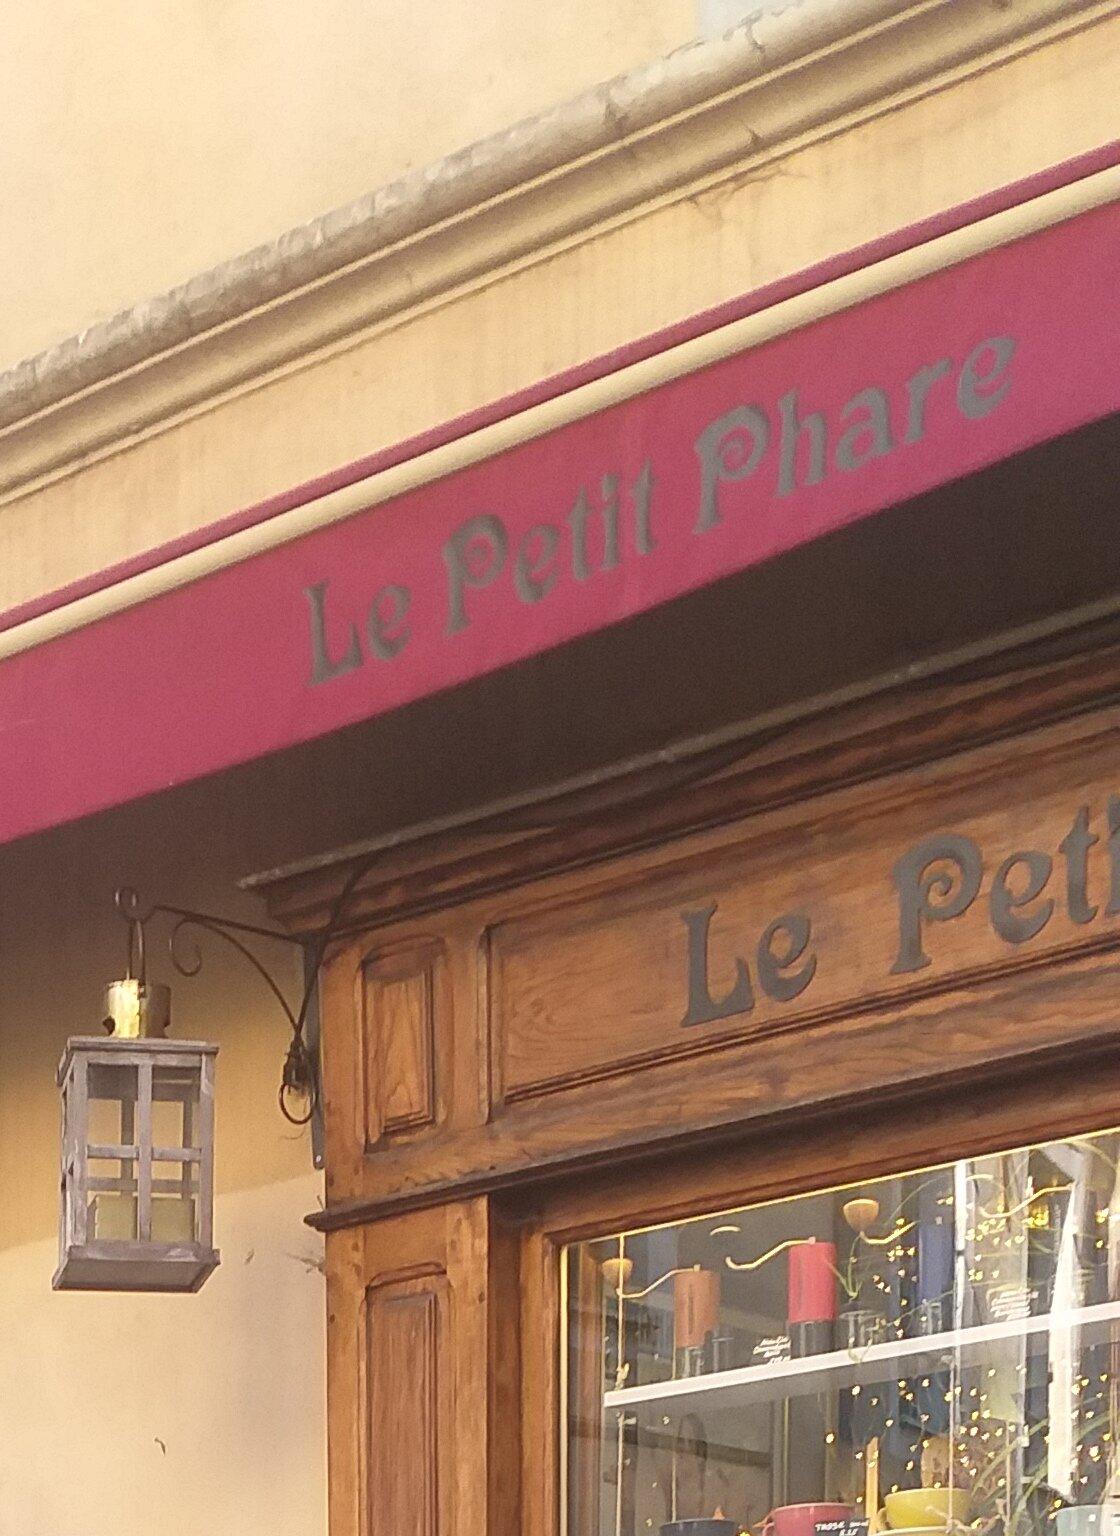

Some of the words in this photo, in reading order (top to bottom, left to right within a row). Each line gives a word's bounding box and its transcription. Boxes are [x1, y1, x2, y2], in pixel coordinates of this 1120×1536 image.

[302, 579, 412, 687] Le
[441, 458, 657, 637] Petit
[692, 334, 1017, 535] Phare
[680, 899, 818, 1028] Le
